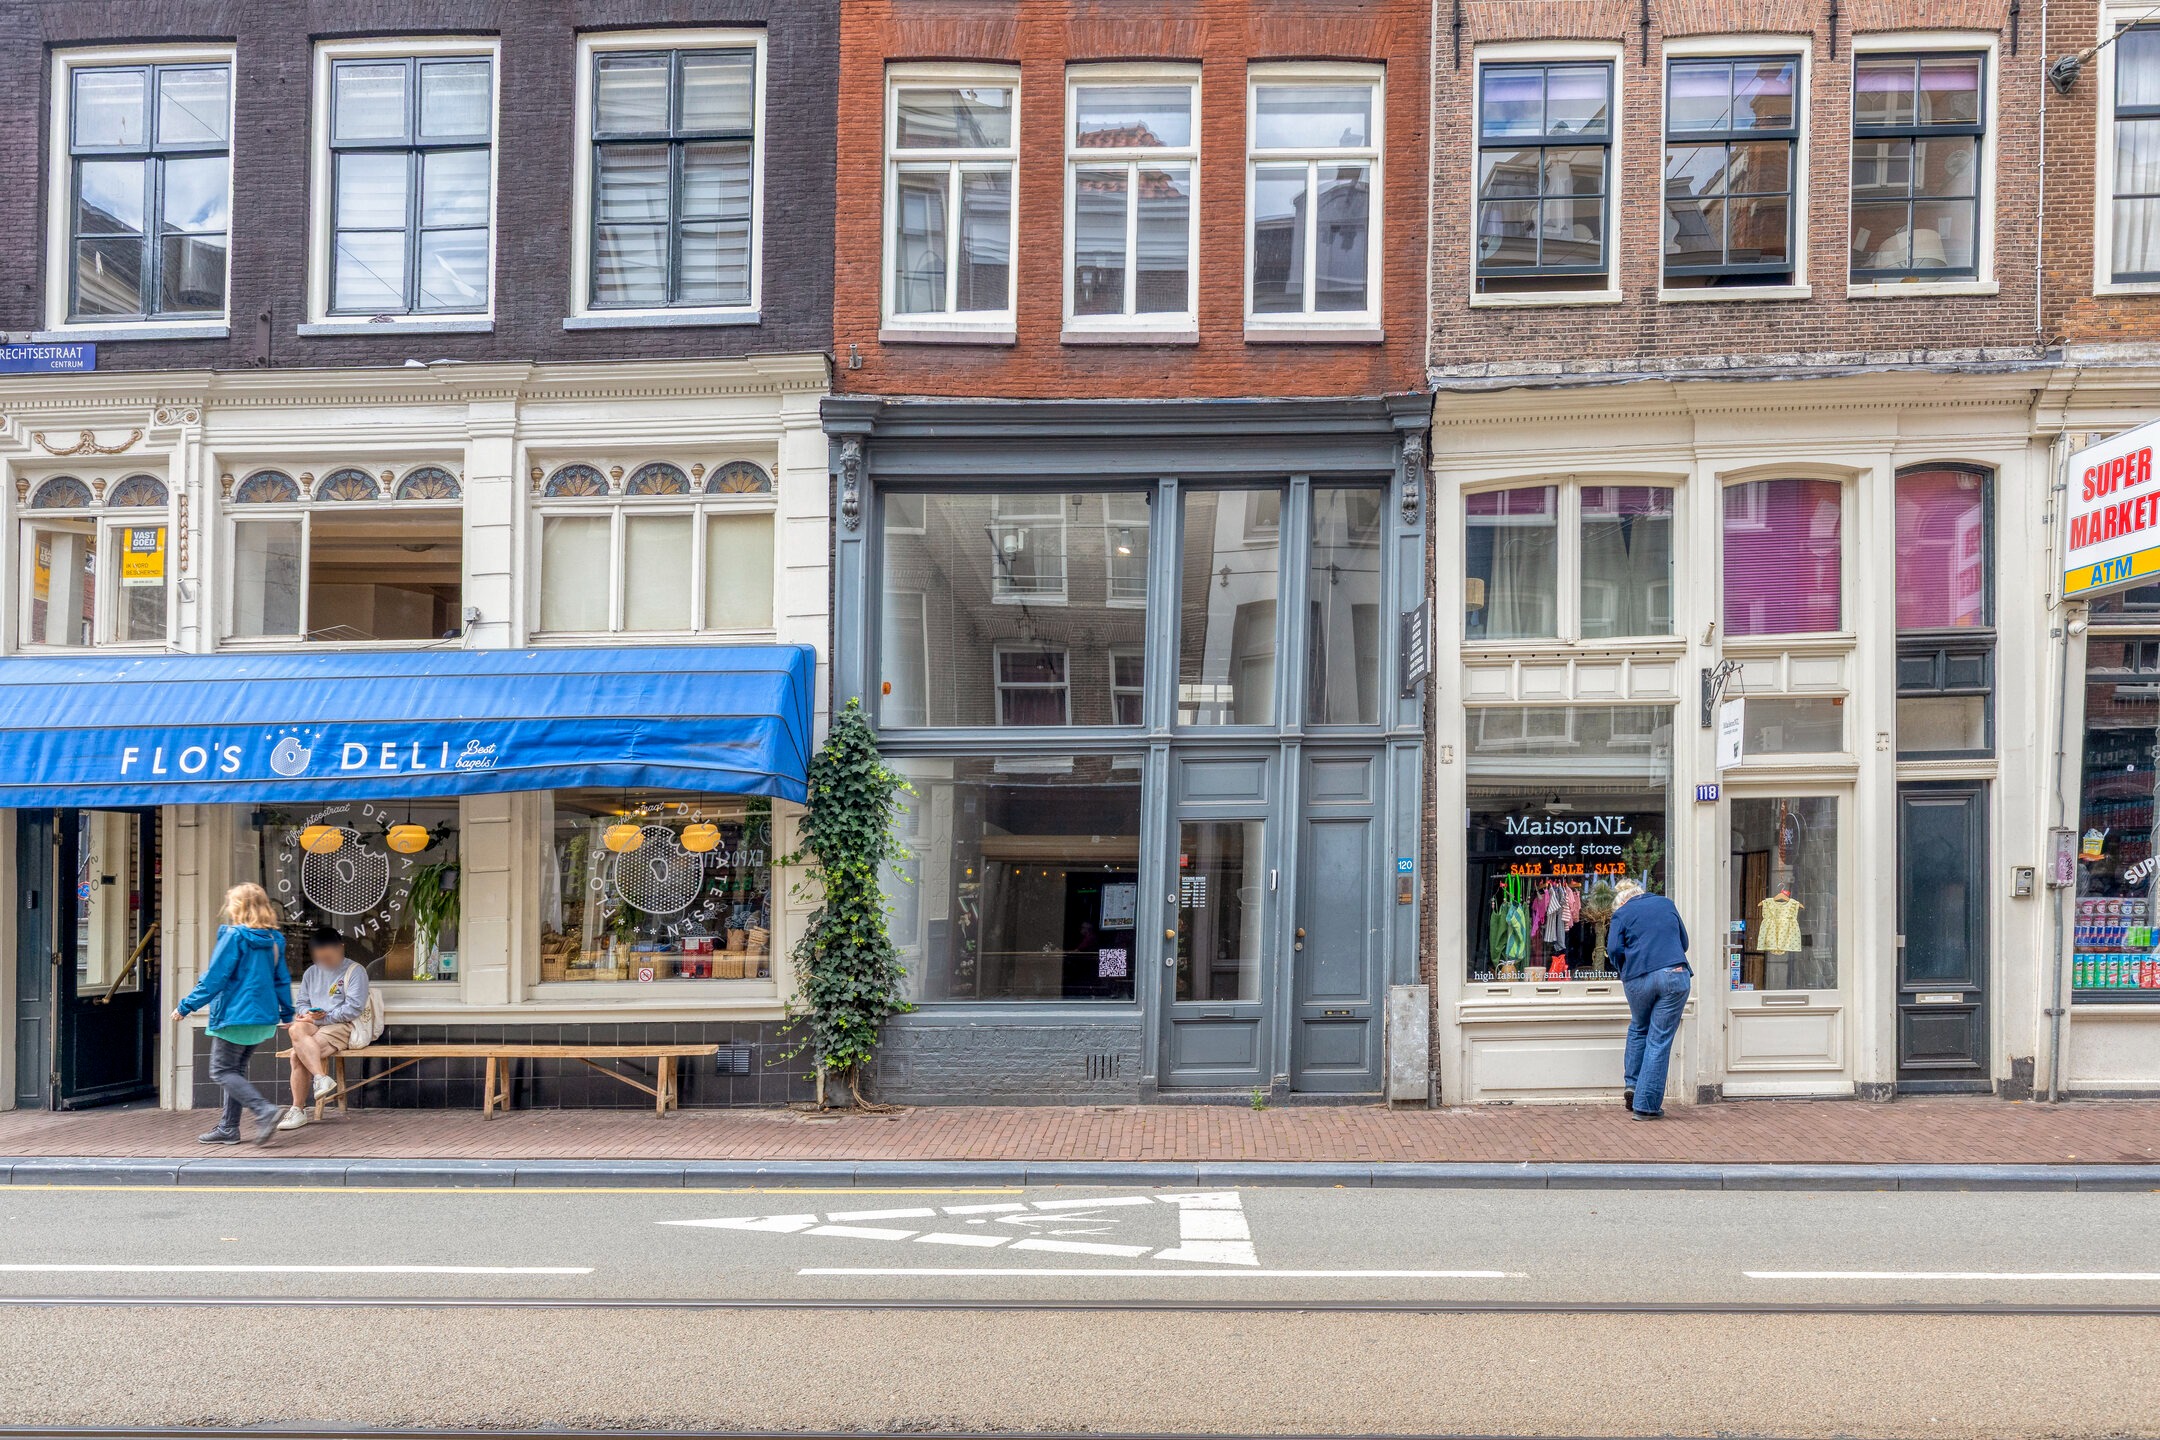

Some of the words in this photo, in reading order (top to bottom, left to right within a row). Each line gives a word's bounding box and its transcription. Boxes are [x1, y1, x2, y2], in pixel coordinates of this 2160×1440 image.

[2082, 446, 2153, 503] SUPER
[2069, 489, 2160, 552] MARKET
[133, 531, 156, 539] VAST
[133, 538, 156, 546] GOED
[2090, 555, 2133, 586] ATM
[461, 739, 496, 755] Best
[120, 742, 242, 775] FLO'S
[340, 741, 449, 770] DELI
[455, 756, 499, 771] bagels!
[1698, 786, 1717, 800] 118
[1504, 816, 1633, 836] MaisonNL
[1514, 843, 1575, 858] concept
[1581, 843, 1622, 855] store
[354, 803, 414, 938] DELICATESSEN
[667, 802, 729, 938] DELICATESSEN
[1398, 860, 1413, 870] 120
[1510, 863, 1542, 875] SALE
[1553, 863, 1584, 875] SALE
[1594, 862, 1626, 875] SALE
[276, 852, 304, 921] FLO'S
[589, 850, 617, 919] FLO'S
[1474, 971, 1494, 982] high
[1544, 969, 1572, 979] small
[1574, 969, 1618, 979] furniture
